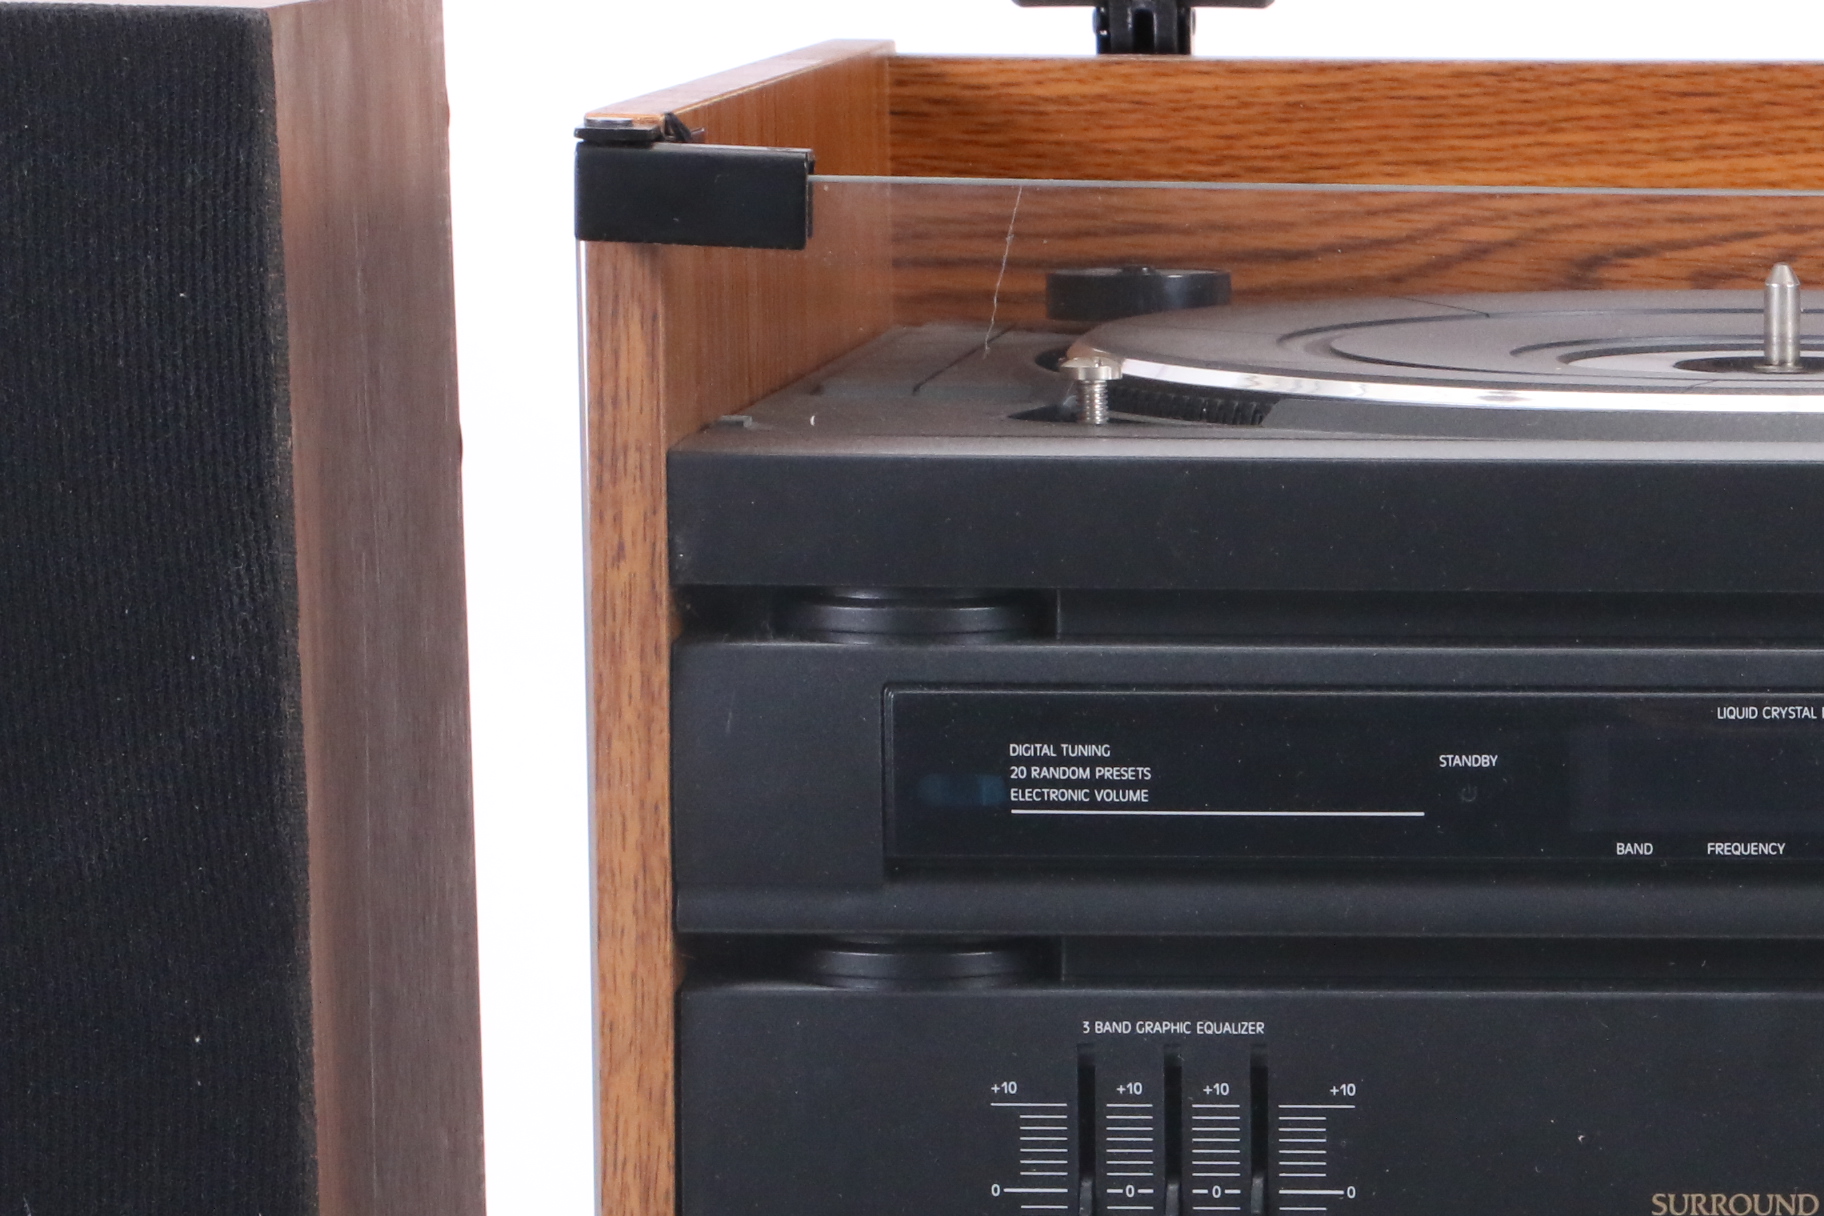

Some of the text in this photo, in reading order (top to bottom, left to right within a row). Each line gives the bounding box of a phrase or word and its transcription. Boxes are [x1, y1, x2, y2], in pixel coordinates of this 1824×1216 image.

[1718, 707, 1758, 719] LIQUID
[1763, 706, 1817, 719] CRYSTAL
[1010, 744, 1110, 757] DIGITAL TUNING
[1440, 755, 1498, 767] STANDBY
[1011, 766, 1151, 780] 20 RANDOM PRESETS
[1011, 788, 1148, 802] ELECTRONIC VOLUME
[1617, 843, 1653, 855] BAND
[1708, 843, 1785, 855] FREQUENCY
[1083, 1021, 1264, 1034] 3 BAND GRAPHIC EQUALIZER
[991, 1082, 1017, 1094] +10
[1117, 1082, 1142, 1095] +10
[1203, 1083, 1229, 1095] +10
[1330, 1084, 1356, 1096] +10
[992, 1184, 1000, 1196] 0
[1126, 1185, 1134, 1197] 0
[1212, 1186, 1221, 1198] 0
[1347, 1186, 1355, 1198] 0
[1652, 1194, 1819, 1216] SURROUND
